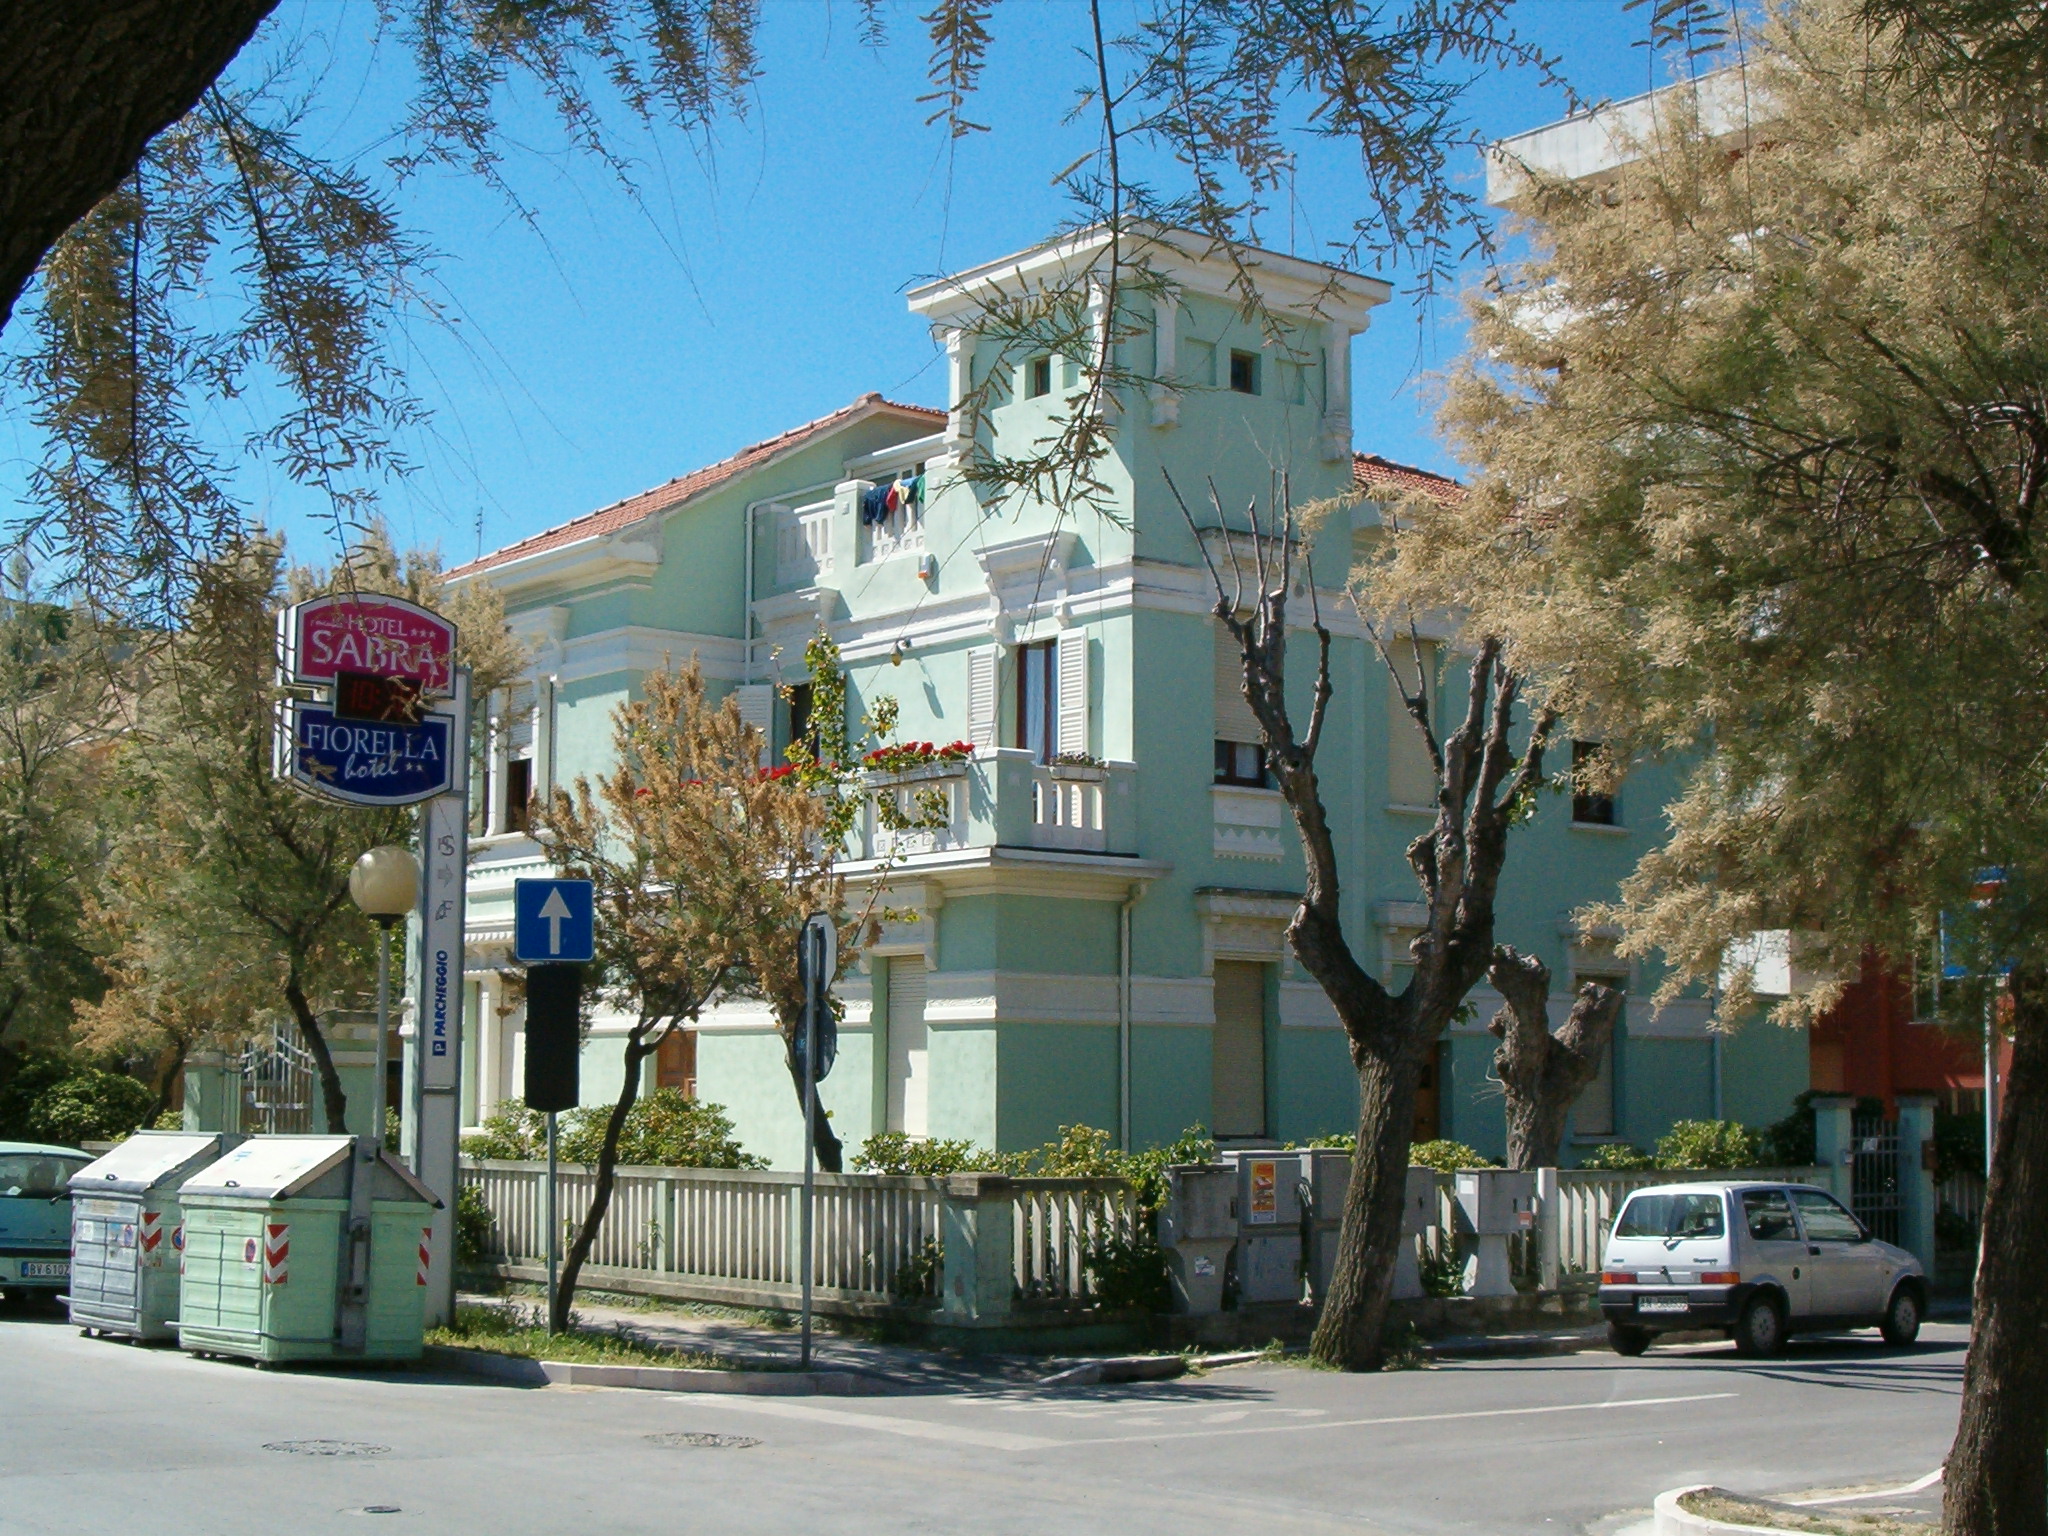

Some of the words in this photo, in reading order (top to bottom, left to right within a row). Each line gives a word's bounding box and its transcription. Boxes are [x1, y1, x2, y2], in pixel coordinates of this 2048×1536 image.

[348, 614, 408, 636] HOTEL
[311, 629, 439, 676] SABRA
[307, 723, 440, 761] FIORELLA
[344, 750, 400, 780] hotel
[434, 950, 448, 1037] PARCHEGGIO
